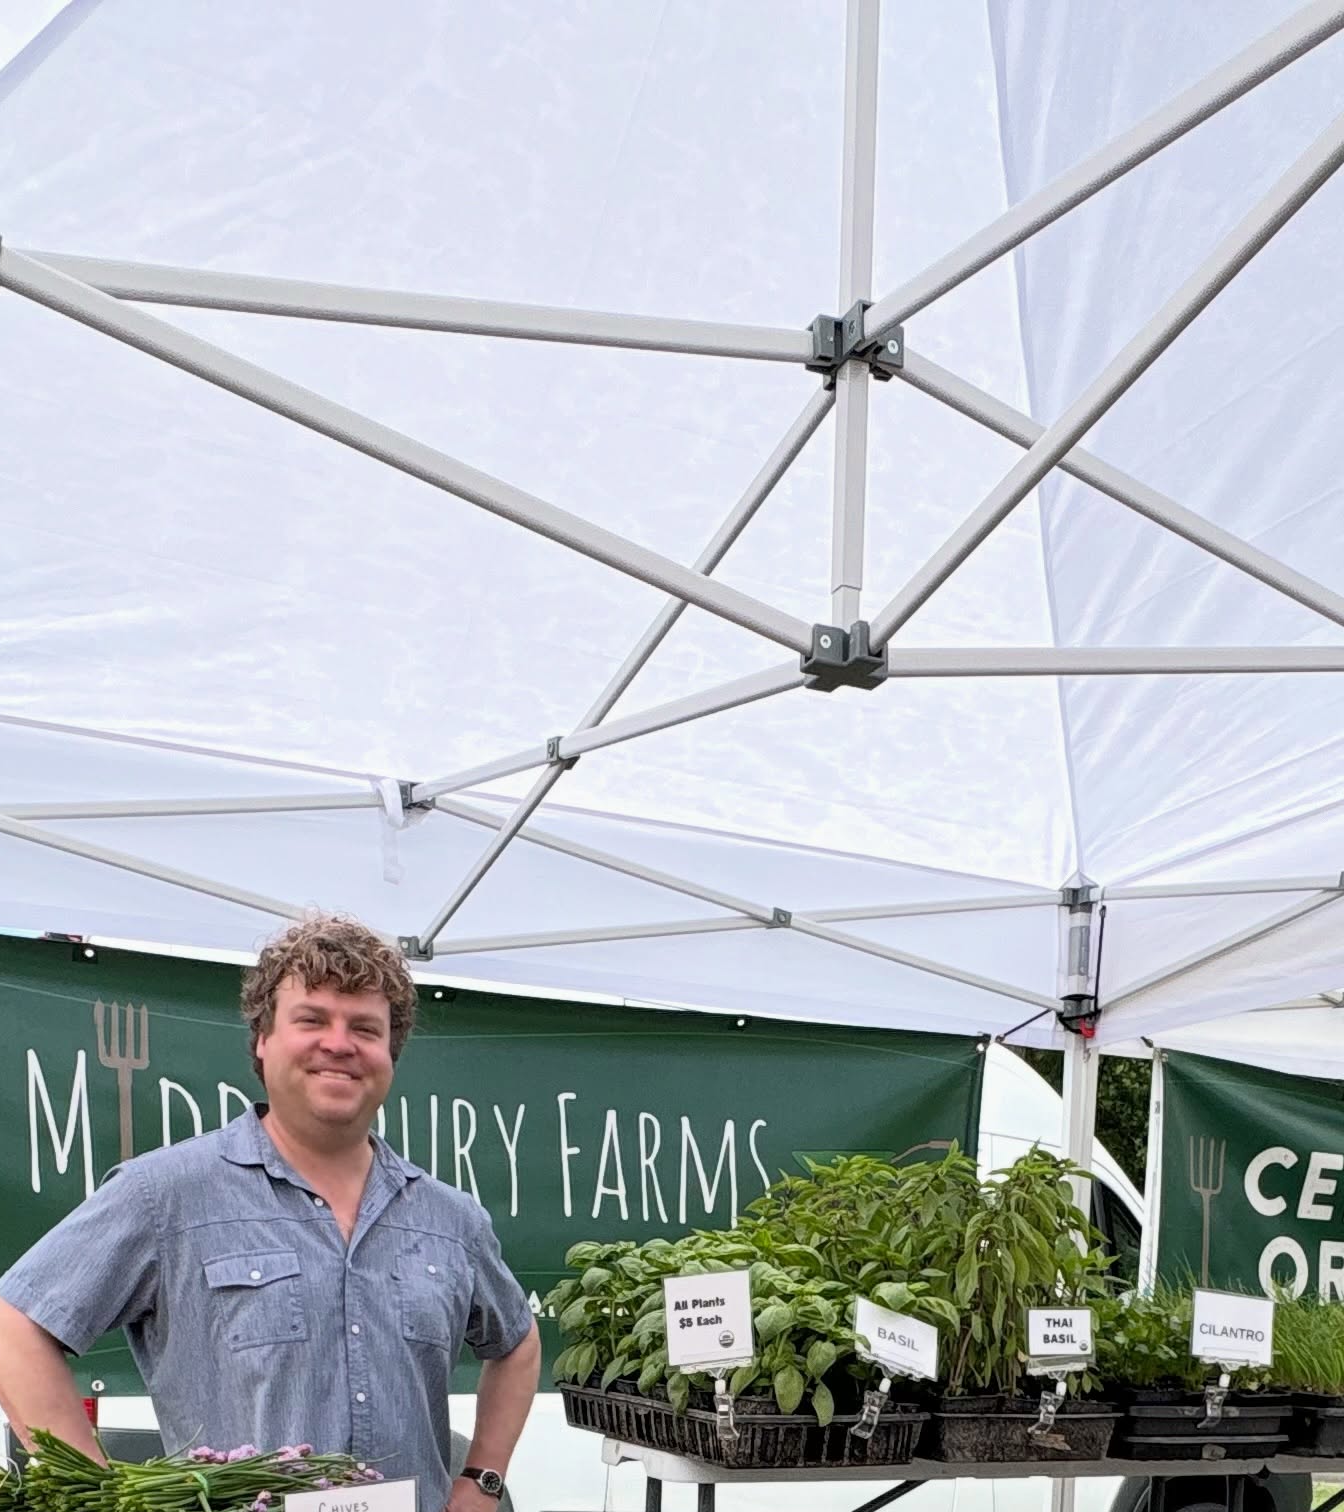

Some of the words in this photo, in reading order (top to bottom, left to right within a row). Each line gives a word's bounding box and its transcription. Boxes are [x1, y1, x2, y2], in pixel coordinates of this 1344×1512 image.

[556, 1091, 773, 1228] FARMS
[674, 1300, 688, 1311] All
[691, 1297, 726, 1309] Plants
[697, 1315, 723, 1326] Each
[1045, 1317, 1073, 1328] THAI
[877, 1326, 919, 1352] BASIL
[1043, 1333, 1077, 1344] BASIL
[1199, 1322, 1265, 1342] CILANTRO
